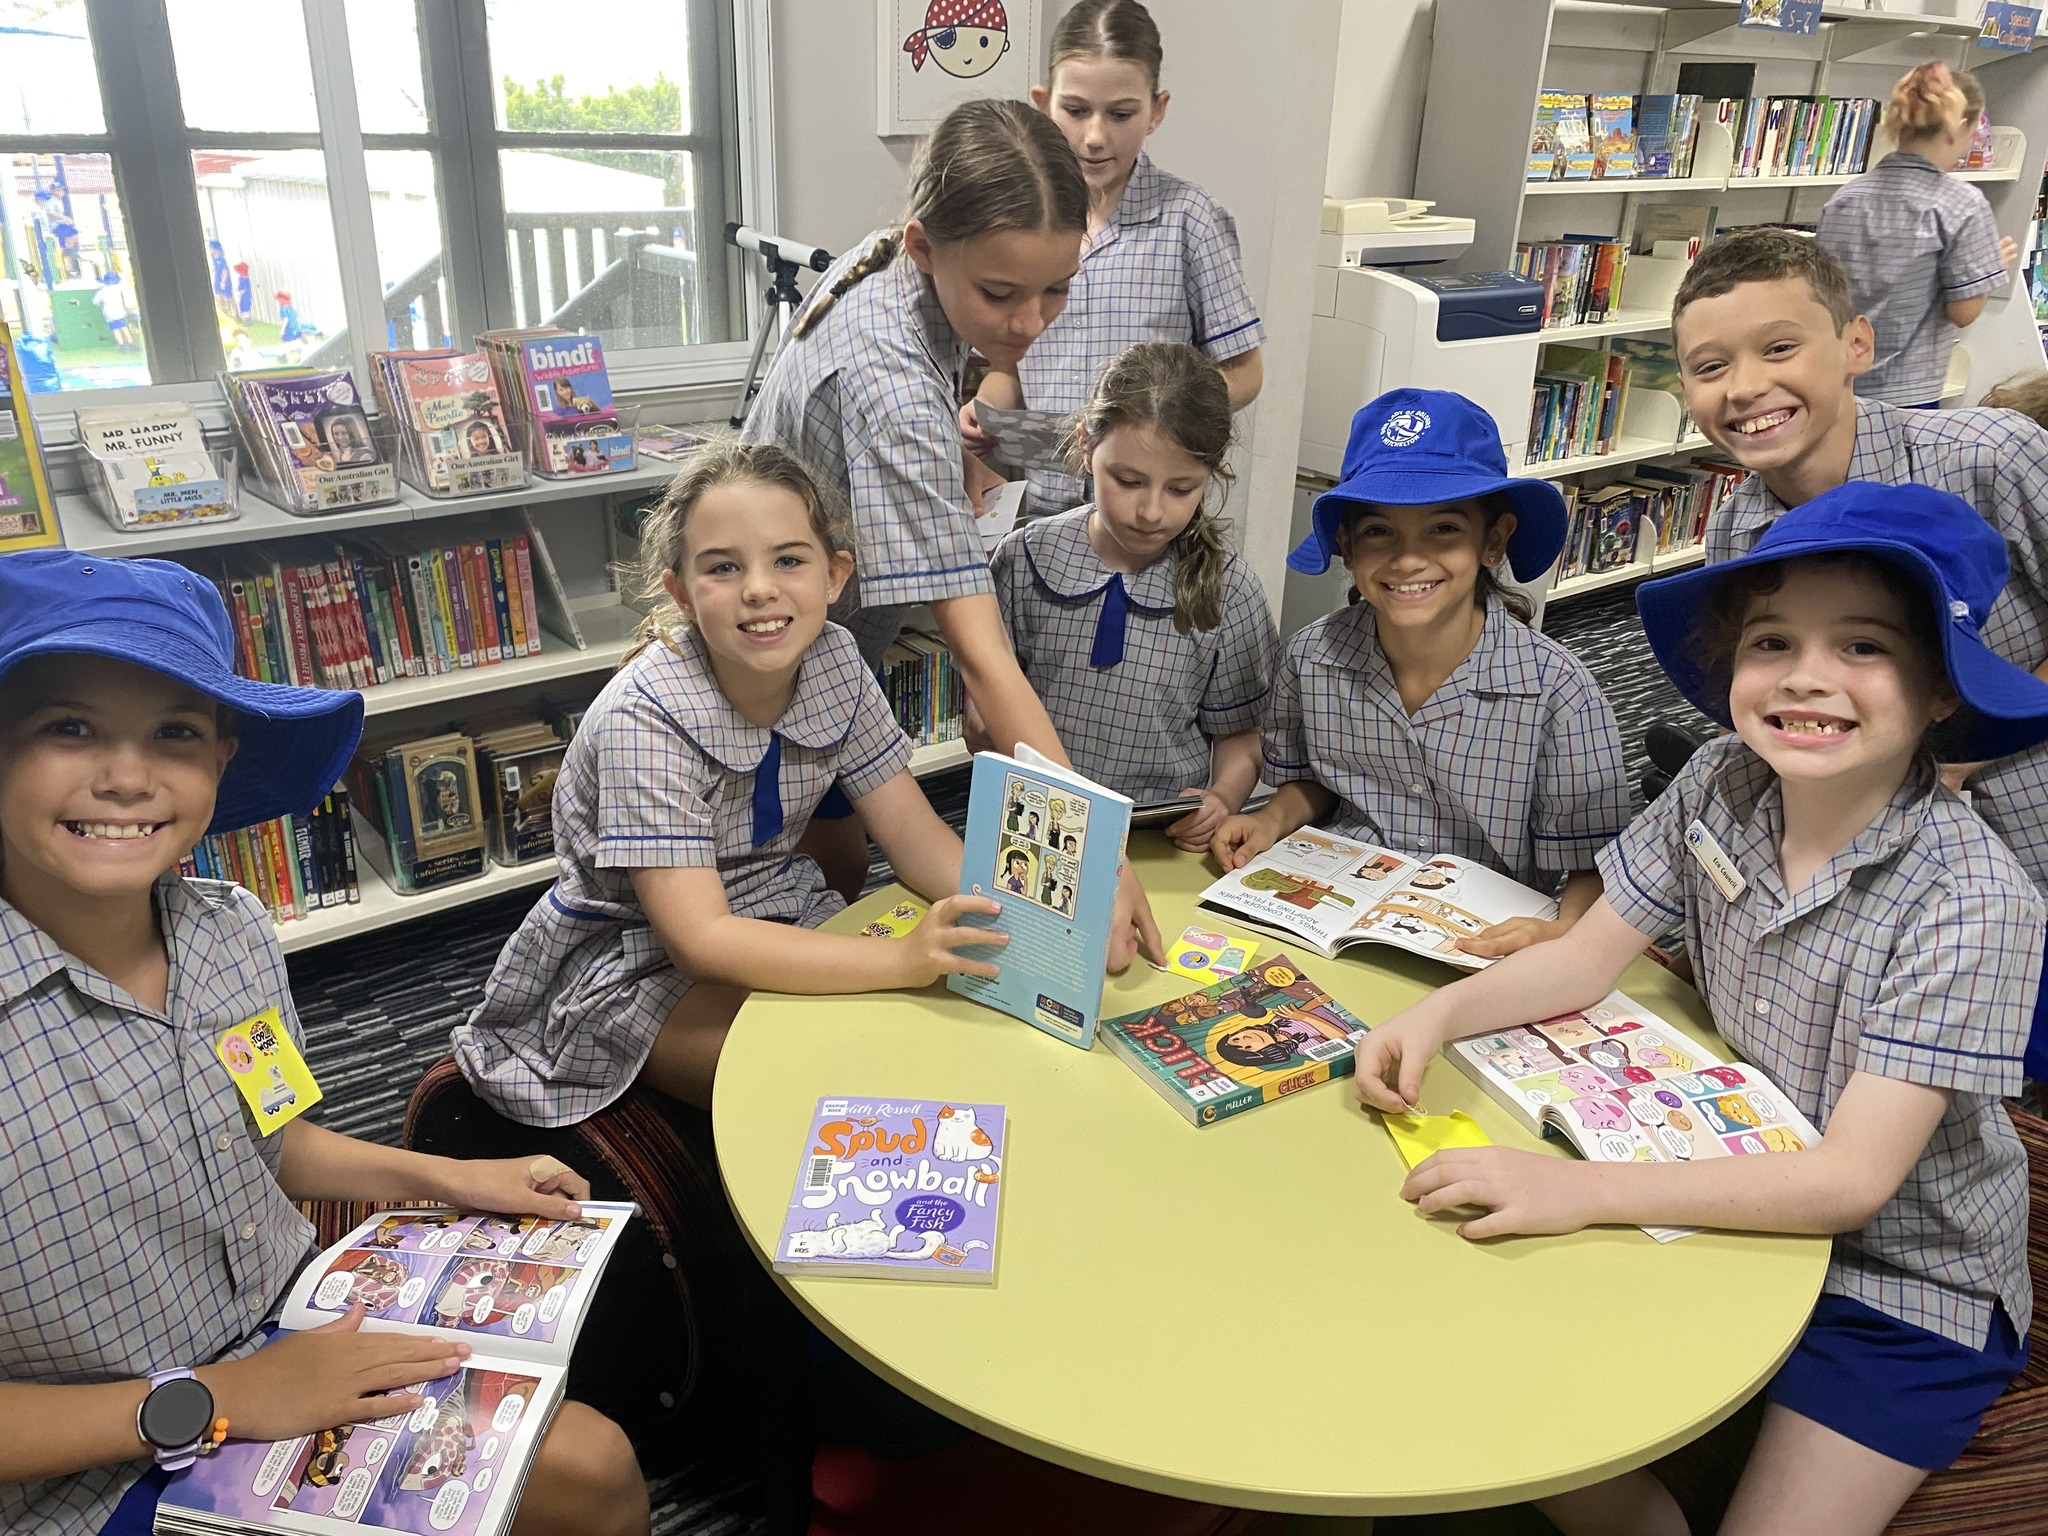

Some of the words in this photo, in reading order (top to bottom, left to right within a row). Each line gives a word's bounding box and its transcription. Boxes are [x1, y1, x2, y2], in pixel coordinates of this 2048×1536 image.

[2009, 11, 2033, 29] Special
[1999, 30, 2031, 48] Collection
[1718, 102, 1730, 123] U
[1769, 109, 1782, 130] W
[529, 341, 594, 370] bindi
[560, 363, 600, 378] Adventures
[426, 400, 455, 412] Meet
[425, 409, 463, 424] Pearlie
[104, 440, 132, 452] MR.
[135, 431, 184, 448] FUNNY
[610, 445, 631, 457] bindi
[451, 462, 466, 471] Our
[466, 458, 503, 470] Australian
[504, 455, 519, 464] Girl
[318, 475, 334, 484] Our
[335, 470, 373, 483] Australian
[373, 468, 389, 477] Girl
[160, 496, 182, 505] LITTLE
[184, 494, 203, 502] MISS
[180, 488, 198, 496] MEN
[287, 581, 299, 604] BABY
[303, 675, 313, 686] EY
[536, 830, 554, 839] Seri
[294, 826, 312, 861] FLEMBER
[518, 836, 554, 851] Unfortuna
[415, 864, 457, 880] Unfortunate
[458, 858, 480, 868] Events
[434, 857, 460, 867] Series
[1712, 857, 1721, 869] Eco
[1720, 867, 1738, 889] Council
[1219, 889, 1242, 903] WHEN
[1238, 890, 1267, 906] FELINE
[1243, 898, 1283, 918] CONSIDER
[1276, 904, 1319, 926] ADOPTING
[1284, 914, 1295, 922] TO
[1297, 919, 1330, 939] THINGS
[257, 1037, 276, 1052] WORK
[1278, 1071, 1315, 1095] CLICK
[846, 1103, 873, 1116] dith
[875, 1103, 923, 1118] Rossell
[1225, 1095, 1253, 1111] MILLER
[813, 1117, 928, 1160] Spud
[870, 1154, 902, 1166] and
[934, 1198, 948, 1206] the
[906, 1203, 955, 1222] Fancy
[911, 1215, 945, 1231] Fish
